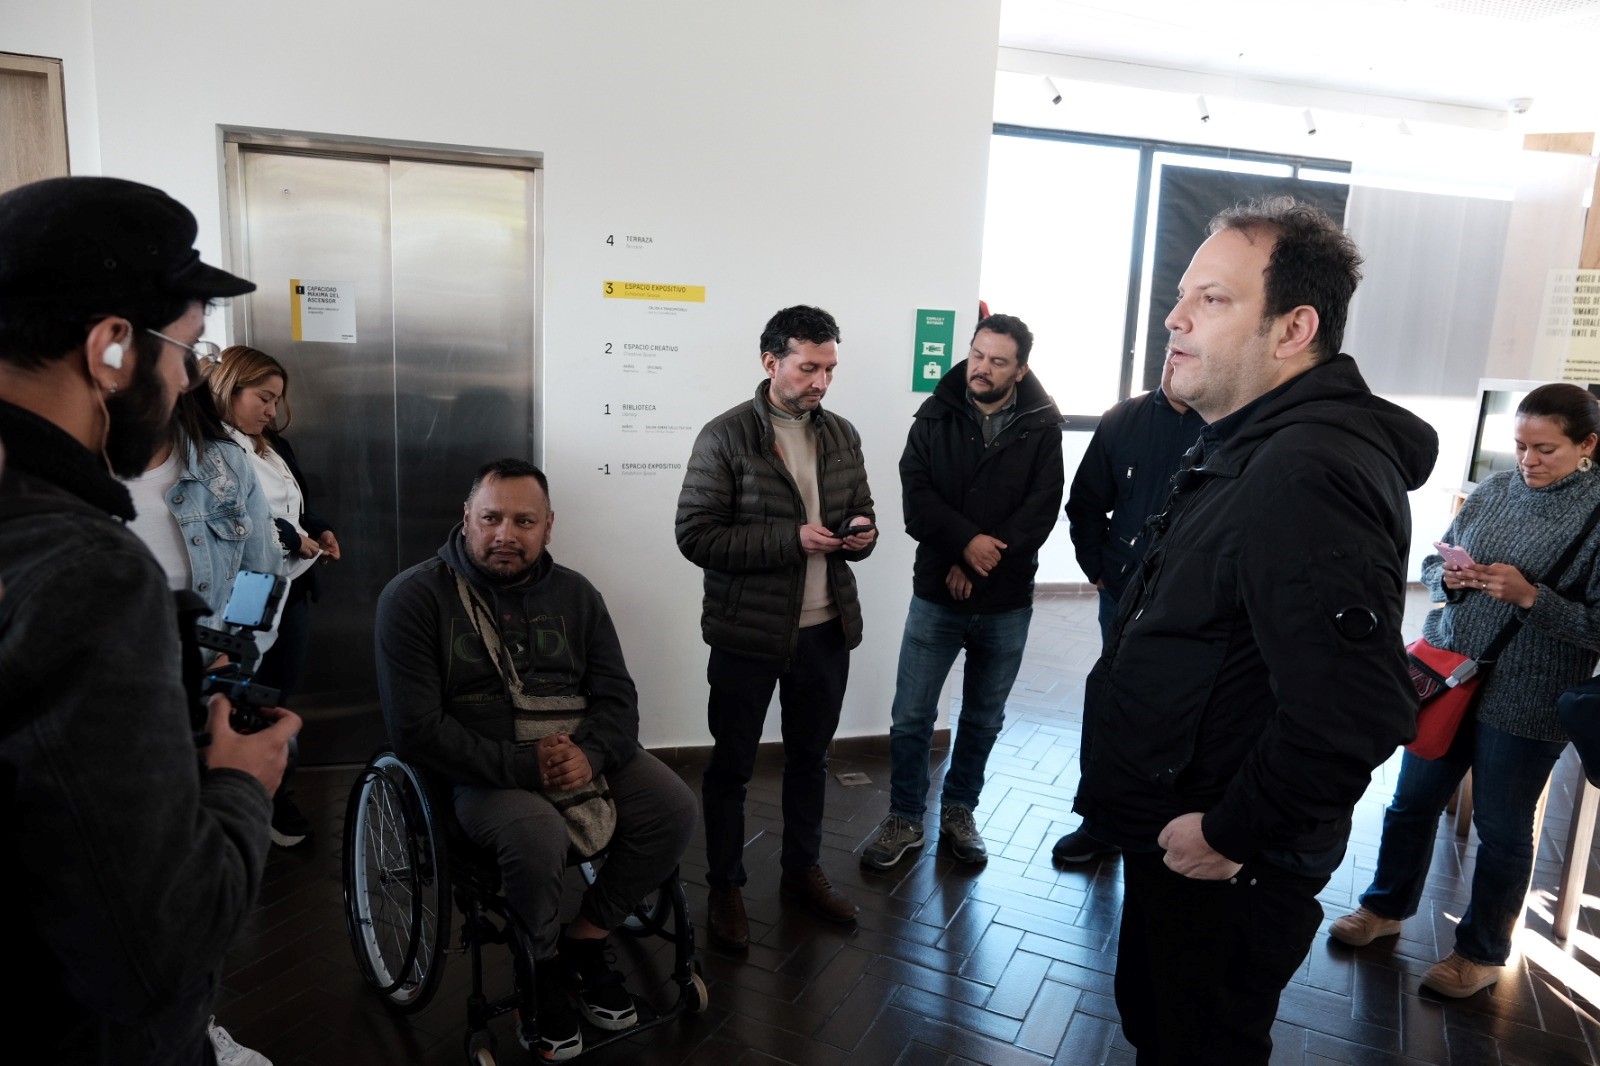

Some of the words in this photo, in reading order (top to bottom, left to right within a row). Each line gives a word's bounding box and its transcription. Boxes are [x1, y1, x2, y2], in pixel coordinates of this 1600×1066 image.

[606, 234, 615, 246] 4
[626, 235, 653, 244] TERRAZA
[1576, 274, 1596, 283] MUSEO
[605, 282, 614, 295] 3
[624, 283, 651, 291] ESPACIO
[651, 285, 687, 293] EXPOSITIVO
[604, 342, 613, 355] 2
[623, 343, 650, 351] ESPACIO
[650, 344, 679, 352] CREATIVO
[603, 403, 611, 415] 1
[622, 403, 657, 411] BIBLIOTECA
[597, 463, 611, 475] -1
